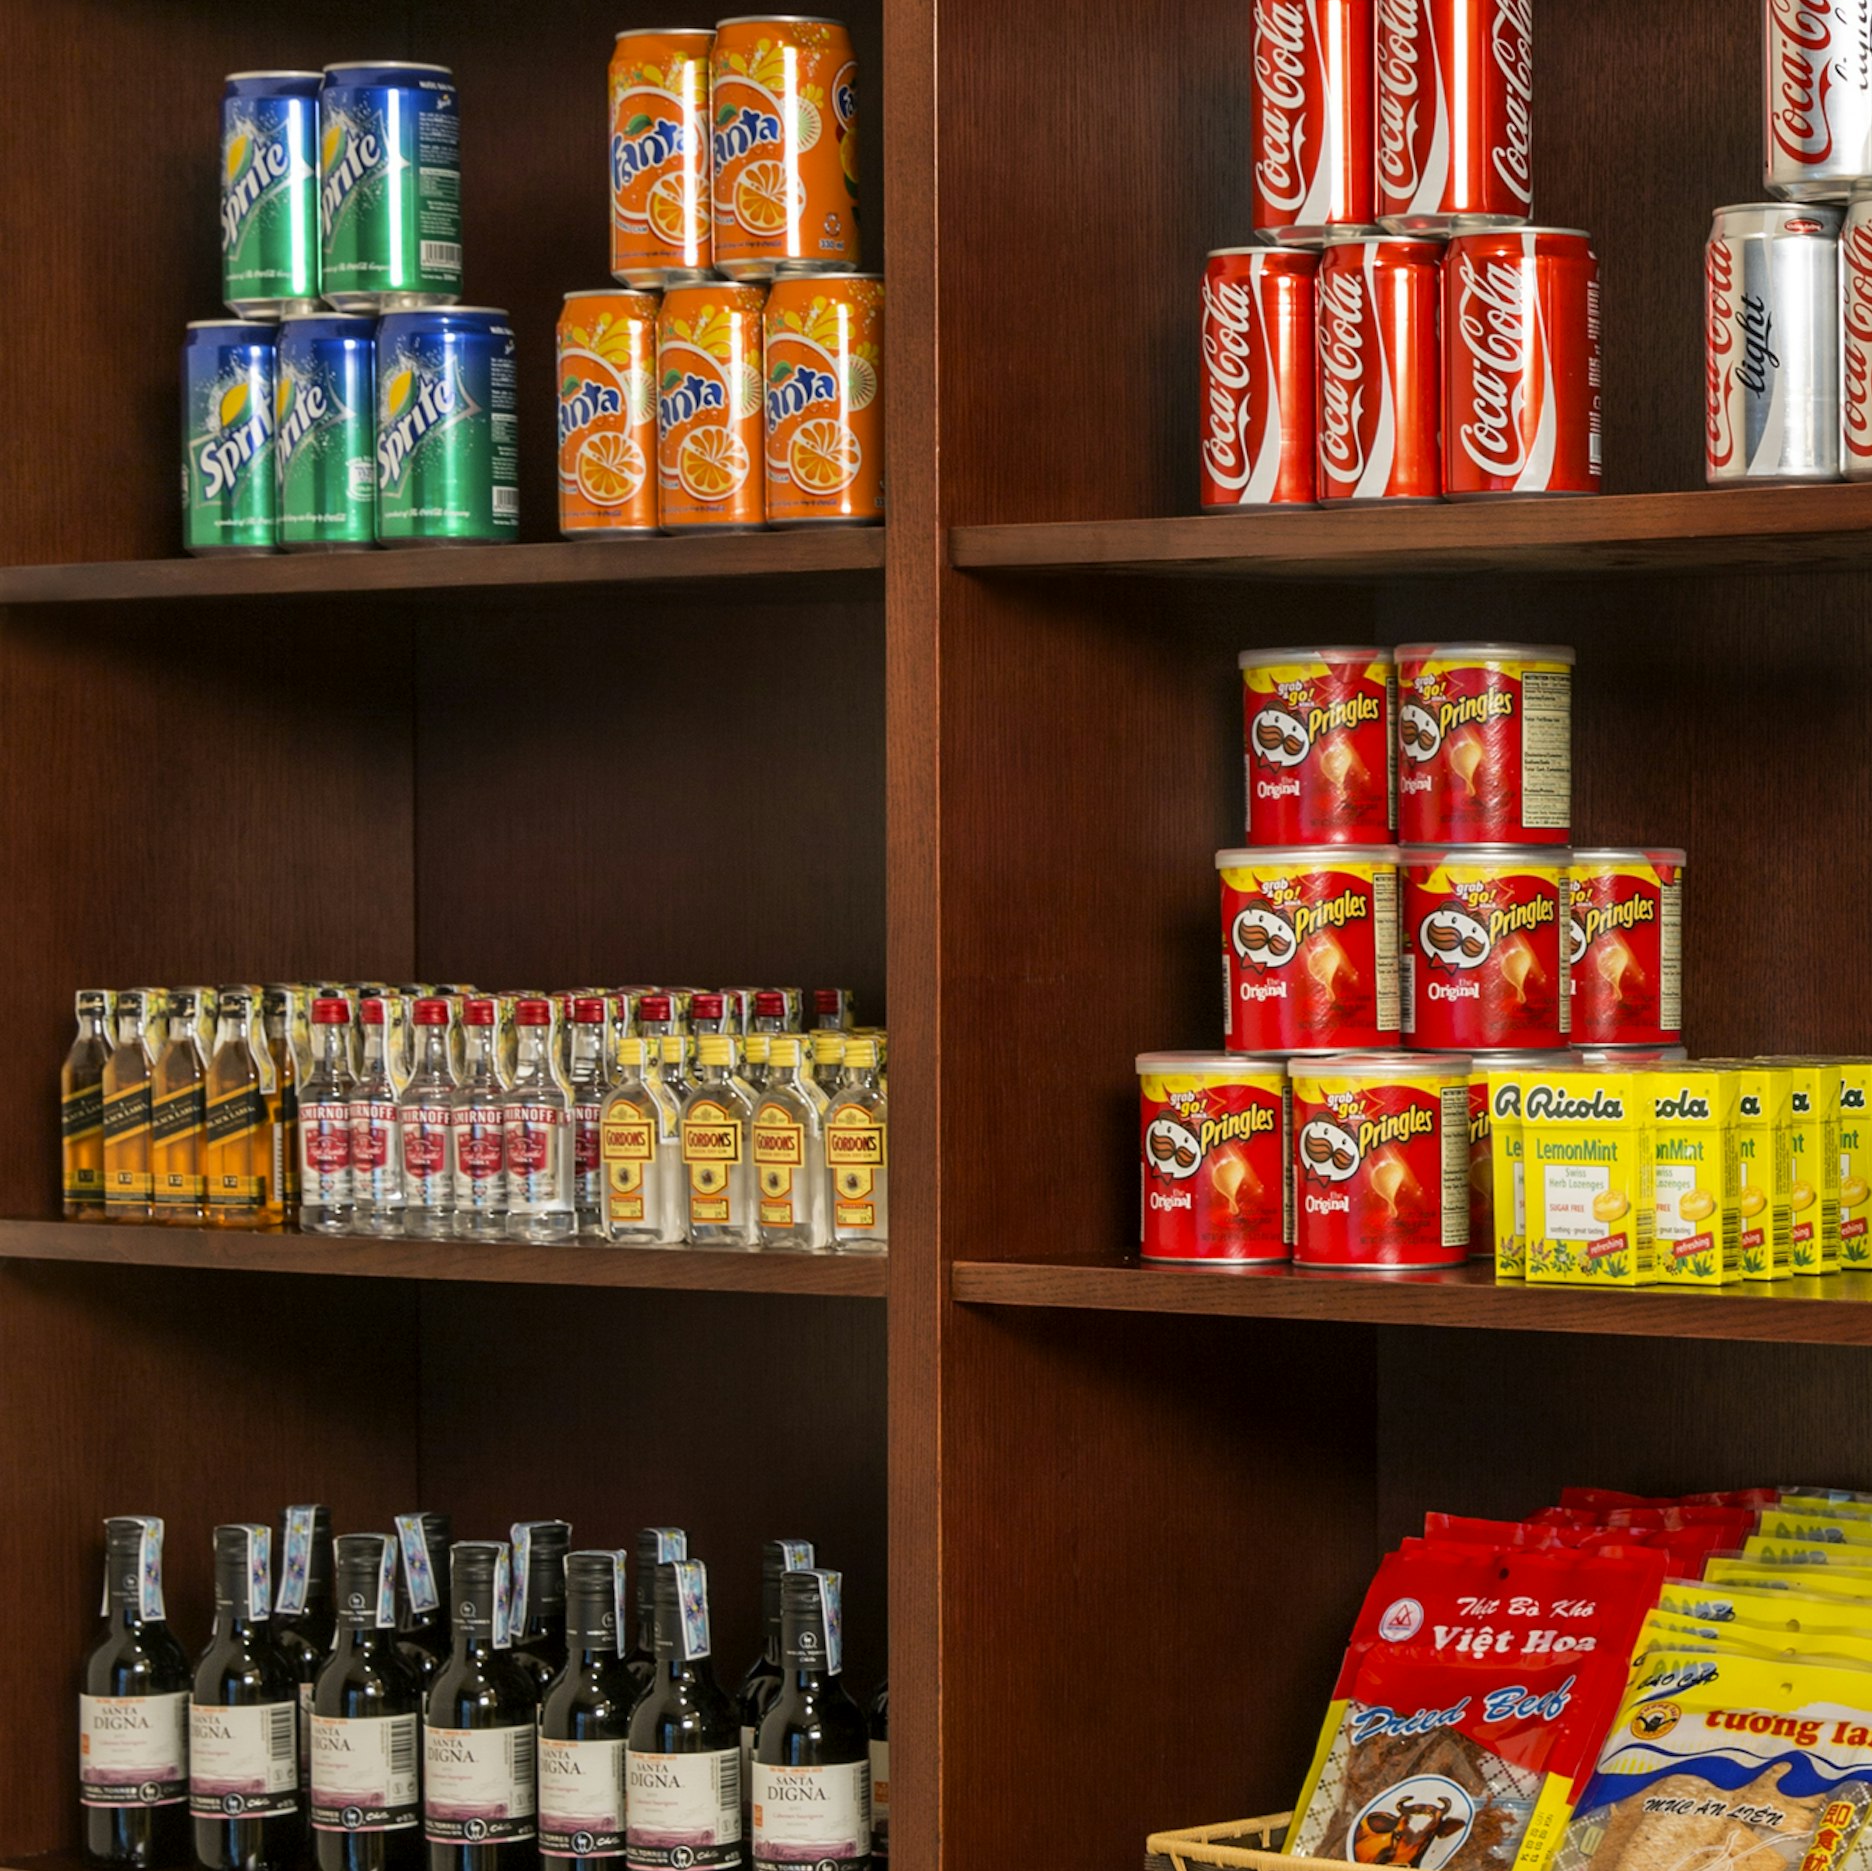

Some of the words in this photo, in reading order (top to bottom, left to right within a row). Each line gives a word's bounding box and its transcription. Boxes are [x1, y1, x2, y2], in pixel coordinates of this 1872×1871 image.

[714, 108, 781, 175] anta
[1736, 292, 1780, 398] light
[1460, 253, 1524, 478] Coca-Cola
[1308, 695, 1379, 736] Pringles
[1296, 895, 1367, 943] Pringles
[1490, 898, 1554, 942] Pringles
[1241, 981, 1288, 1002] Original
[1428, 981, 1480, 1002] Original
[1527, 1086, 1623, 1118] Ricola
[302, 1107, 349, 1120] SMIRNOF
[832, 1135, 877, 1152] GORDON'S
[1537, 1139, 1617, 1161] LemonMint
[1550, 1179, 1565, 1189] Herb
[1568, 1179, 1604, 1191] Lozenges
[1550, 1204, 1568, 1212] SUGAR
[1571, 1204, 1584, 1213] FREE
[1433, 1626, 1514, 1658] Việt
[1521, 1630, 1596, 1653] Hoa
[1352, 1697, 1471, 1745] Dried
[1484, 1676, 1576, 1722] Beef
[95, 1716, 148, 1729] DIGNA
[776, 1776, 813, 1786] SANTA
[767, 1785, 825, 1800] DIGNA
